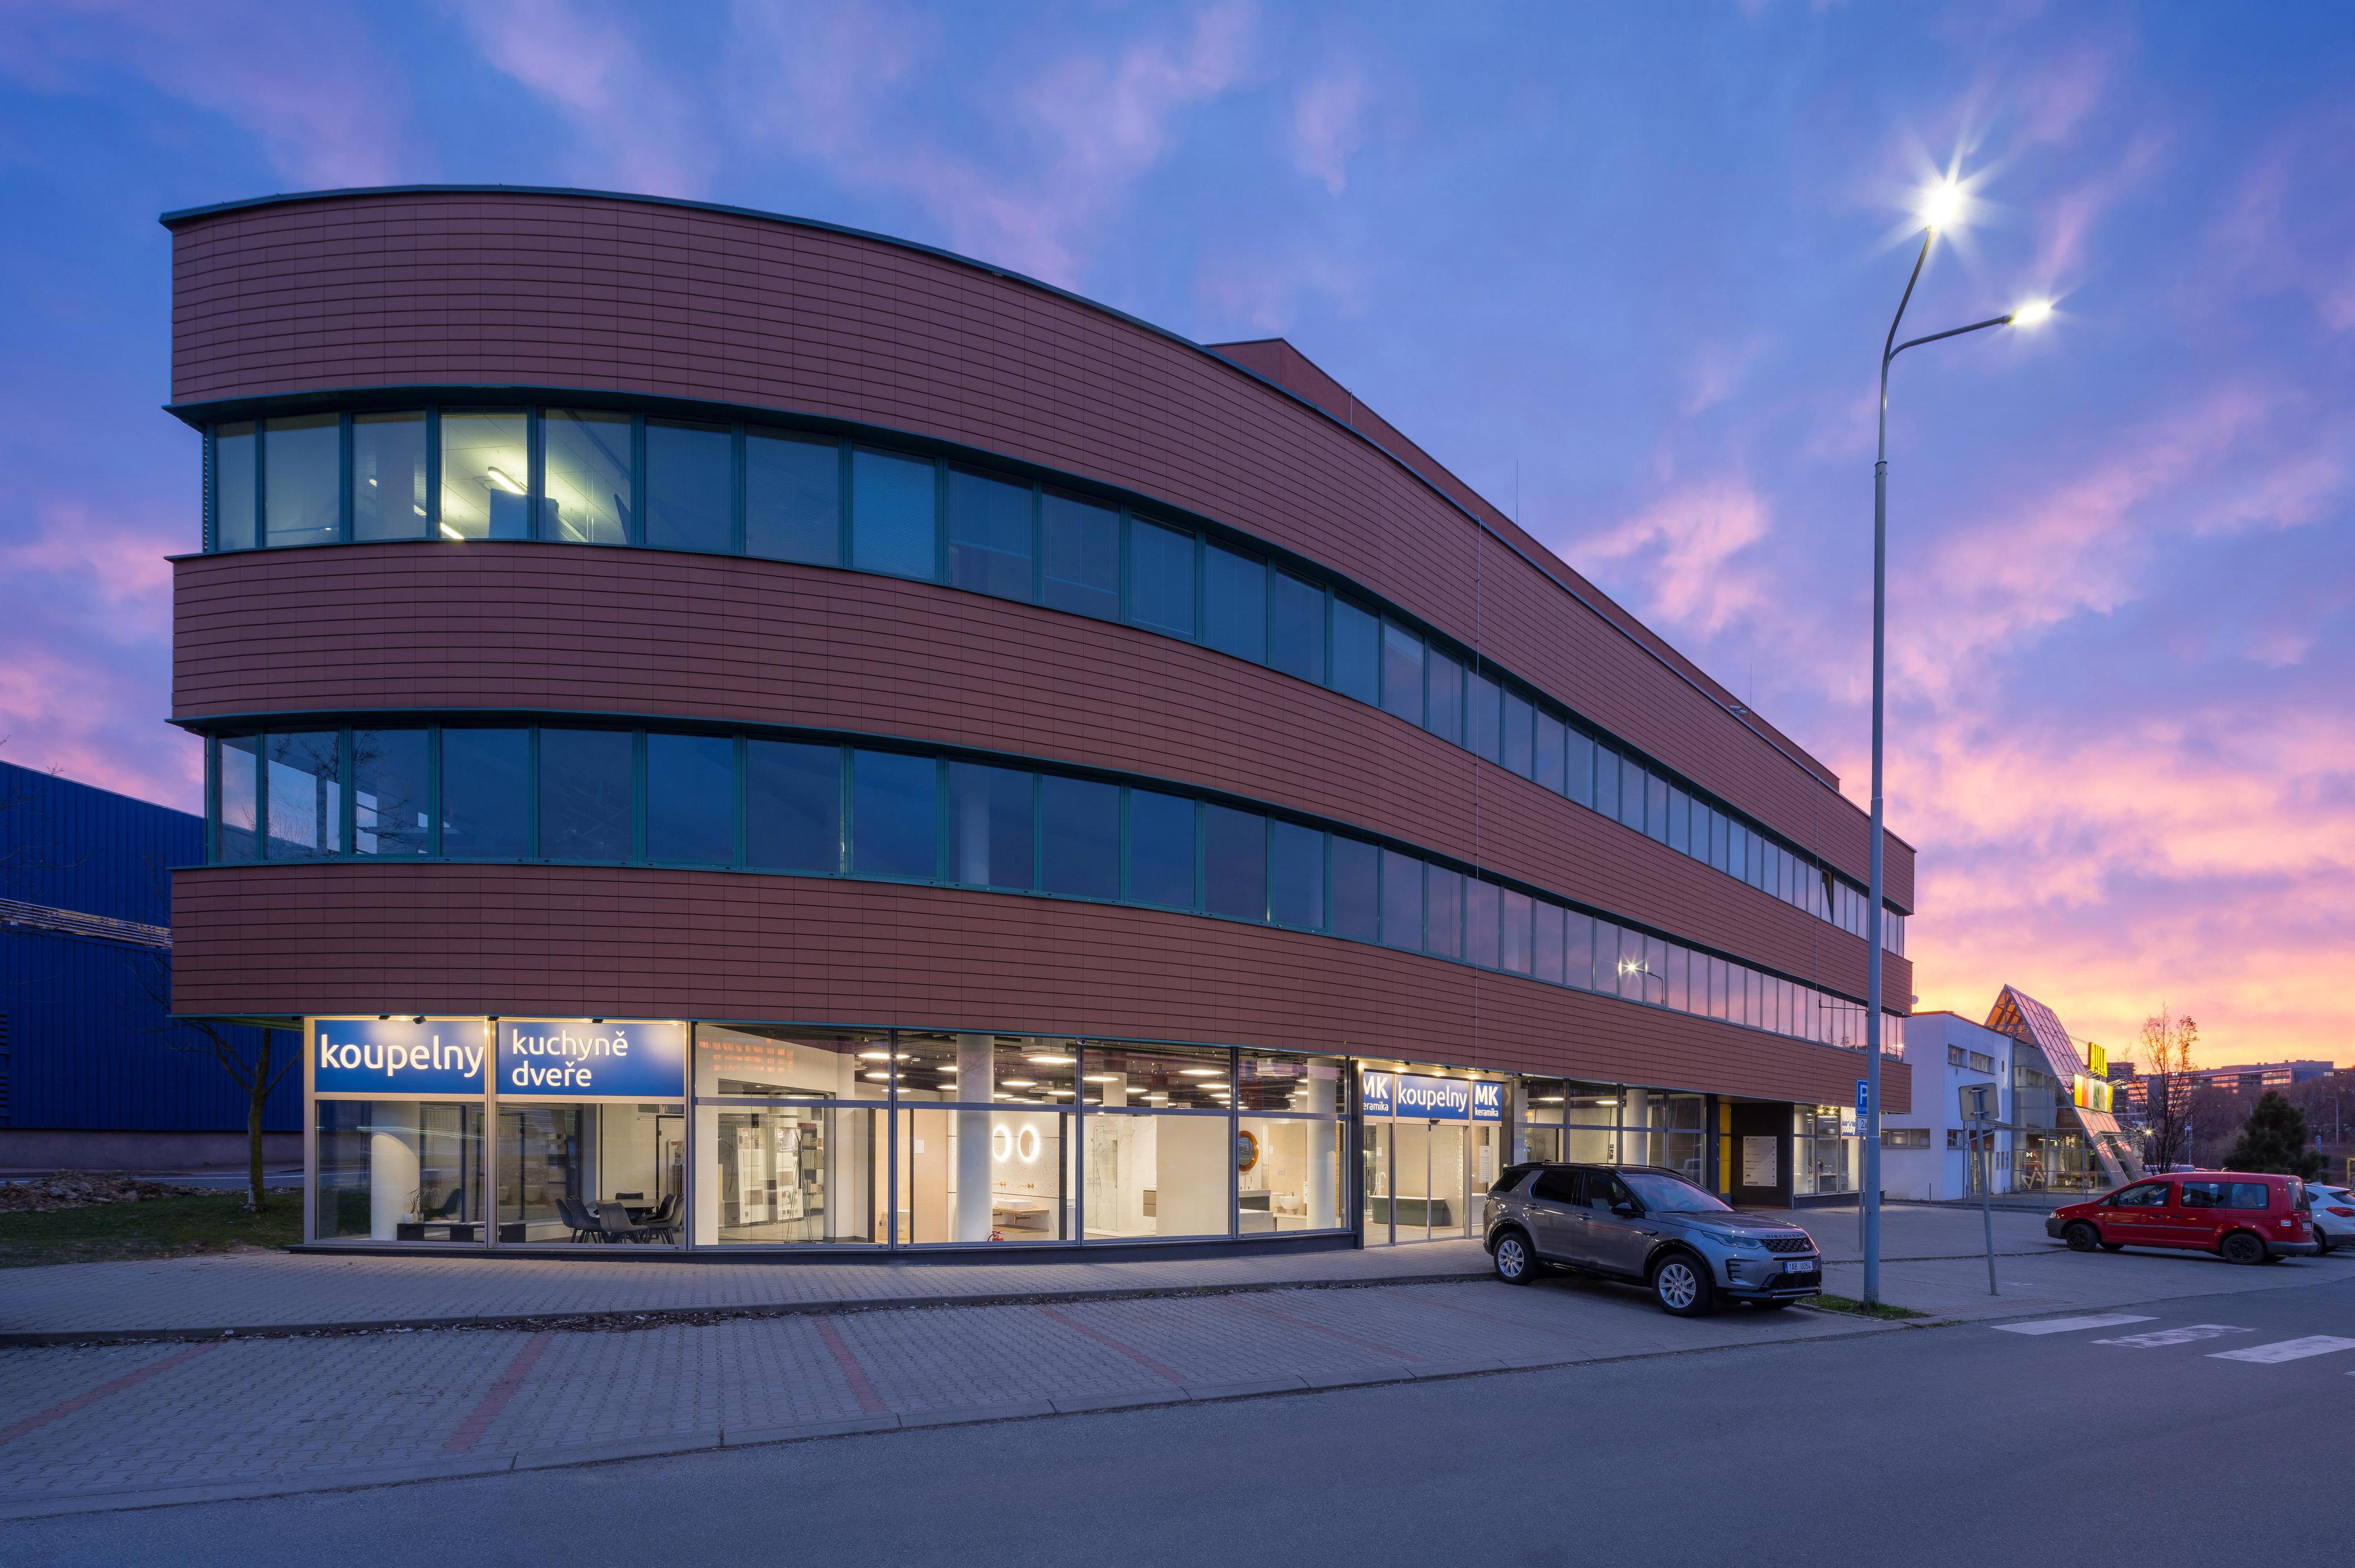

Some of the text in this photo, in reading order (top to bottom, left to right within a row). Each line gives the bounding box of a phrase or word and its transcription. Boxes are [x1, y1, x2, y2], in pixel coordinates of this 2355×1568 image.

[321, 1034, 485, 1078] koupelny
[513, 1029, 628, 1061] kuchyně
[512, 1060, 592, 1086] dveře
[1364, 1075, 1388, 1099] MK
[1398, 1081, 1467, 1112] koupelny
[1475, 1085, 1498, 1106] MK
[1860, 1085, 1868, 1104] P
[1364, 1101, 1389, 1111] eramika
[1475, 1107, 1498, 1117] keramika
[1842, 1123, 1856, 1135] podlahy
